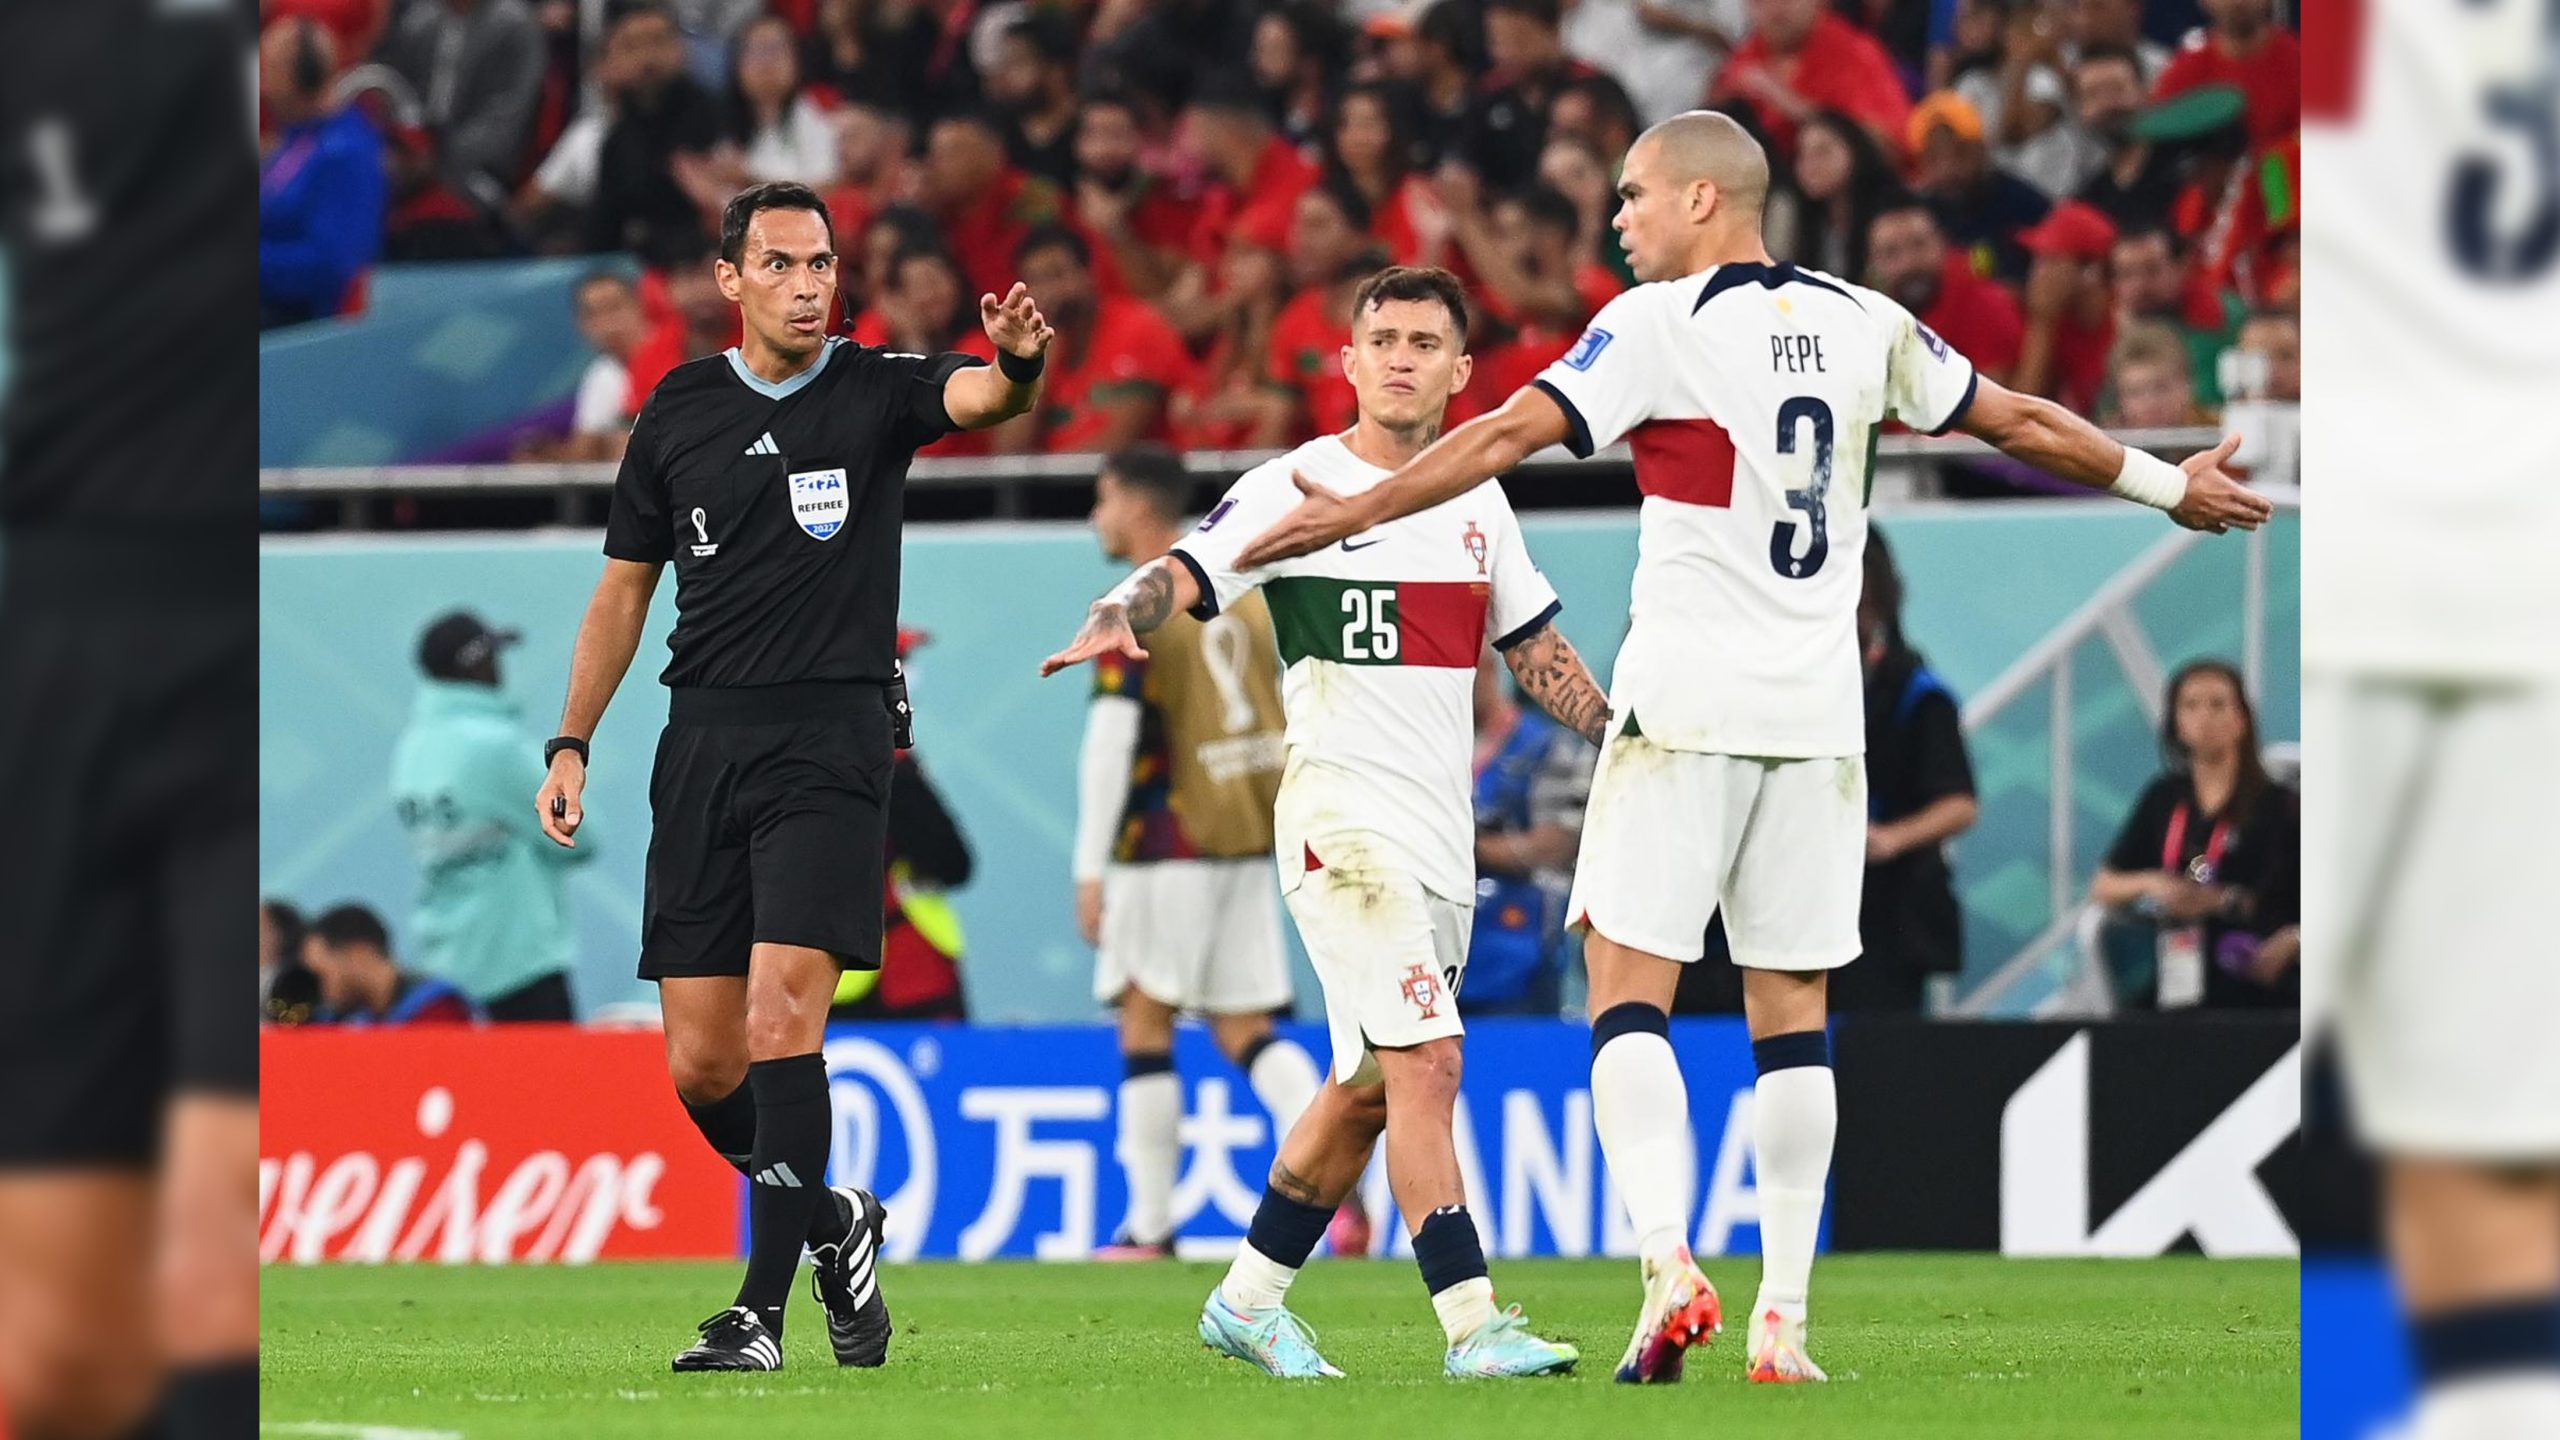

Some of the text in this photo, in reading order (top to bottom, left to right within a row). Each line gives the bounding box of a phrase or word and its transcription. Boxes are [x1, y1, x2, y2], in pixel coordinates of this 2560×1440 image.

[1771, 335, 1826, 372] PEPE
[795, 474, 840, 493] FIFA
[797, 500, 843, 512] REFEREE
[1769, 396, 1834, 580] 3
[812, 523, 834, 533] 2022
[1341, 588, 1399, 660] 25
[957, 1084, 1266, 1262] 万达
[1300, 1086, 1762, 1258] ANA
